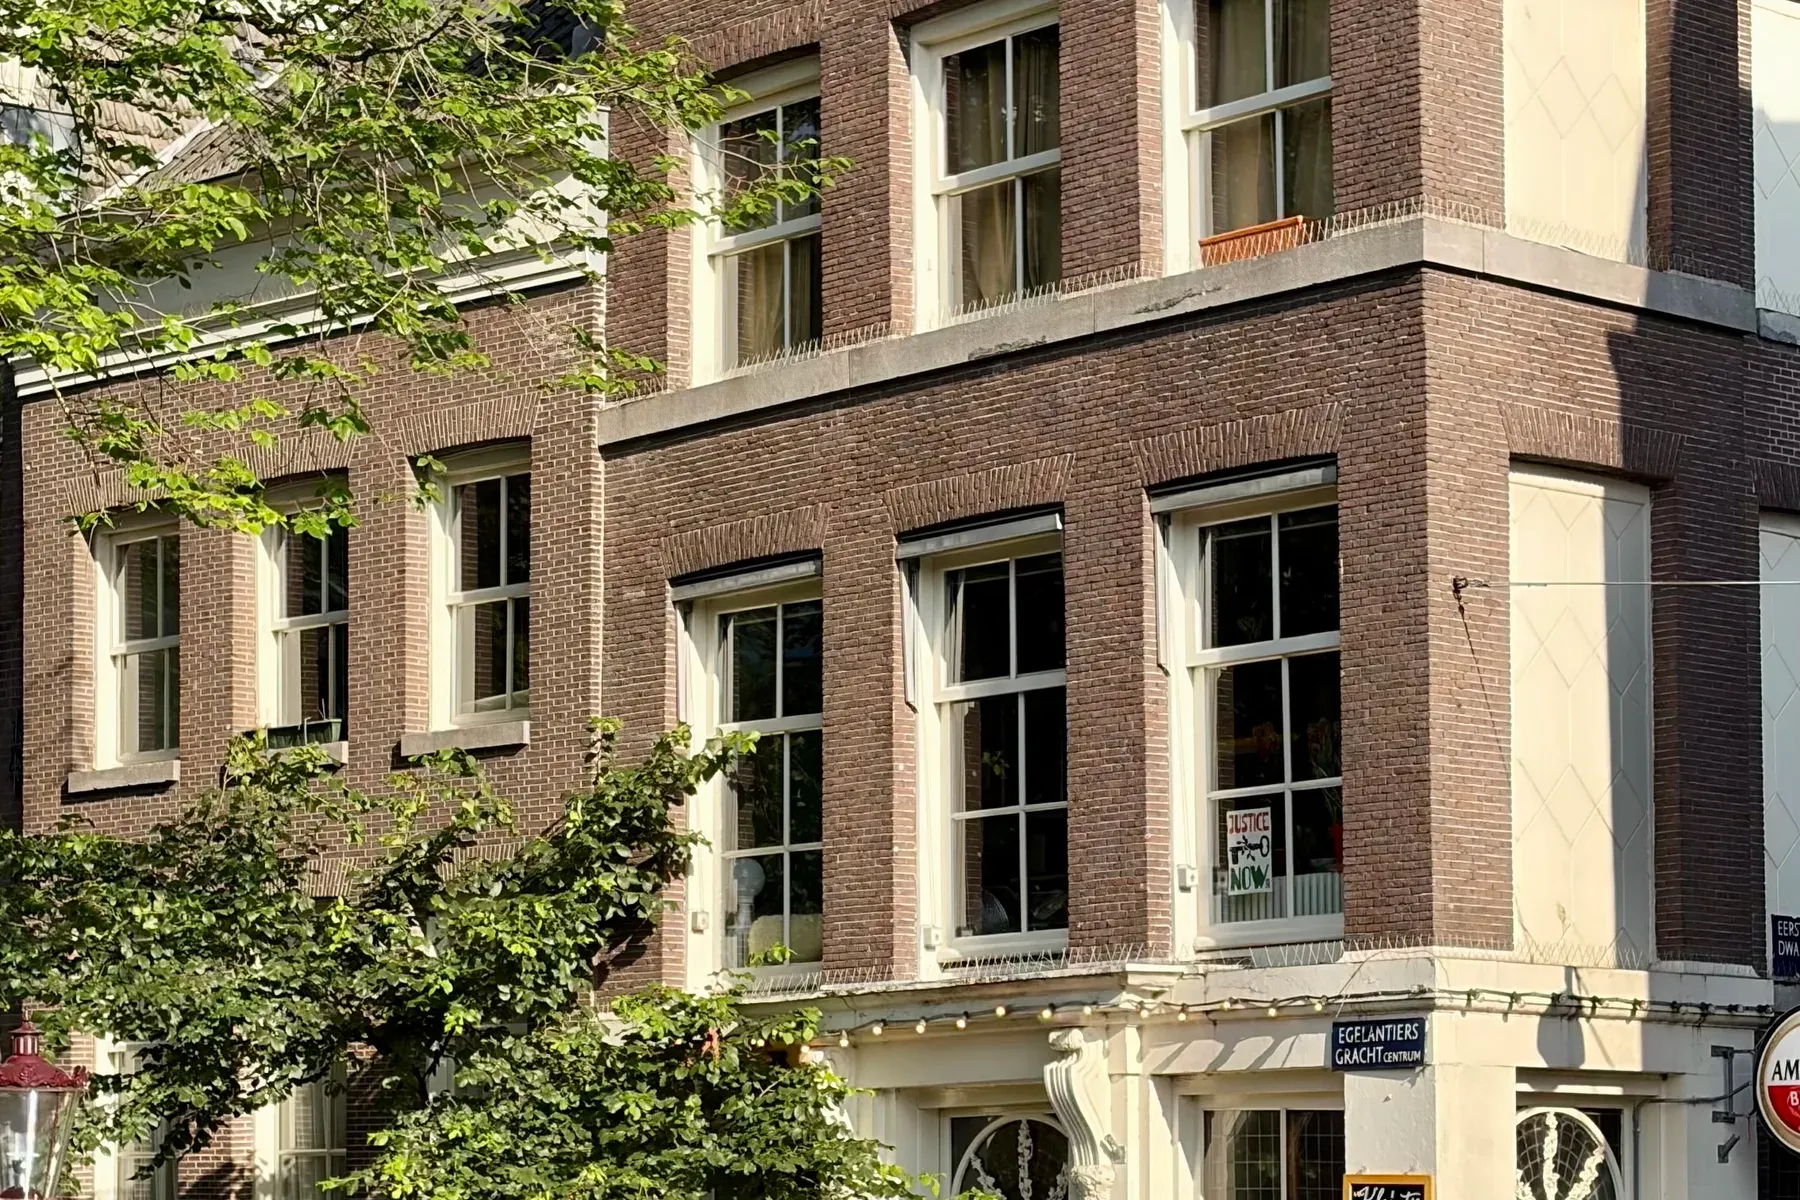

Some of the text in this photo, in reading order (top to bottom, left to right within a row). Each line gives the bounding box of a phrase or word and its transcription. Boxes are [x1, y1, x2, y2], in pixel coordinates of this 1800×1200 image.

[1229, 812, 1270, 834] JUSTICE
[1230, 864, 1270, 892] NOW
[1777, 920, 1800, 937] EERS
[1338, 1023, 1419, 1044] EGELANTIERS
[1335, 1046, 1421, 1065] GRACHT CENTRUM
